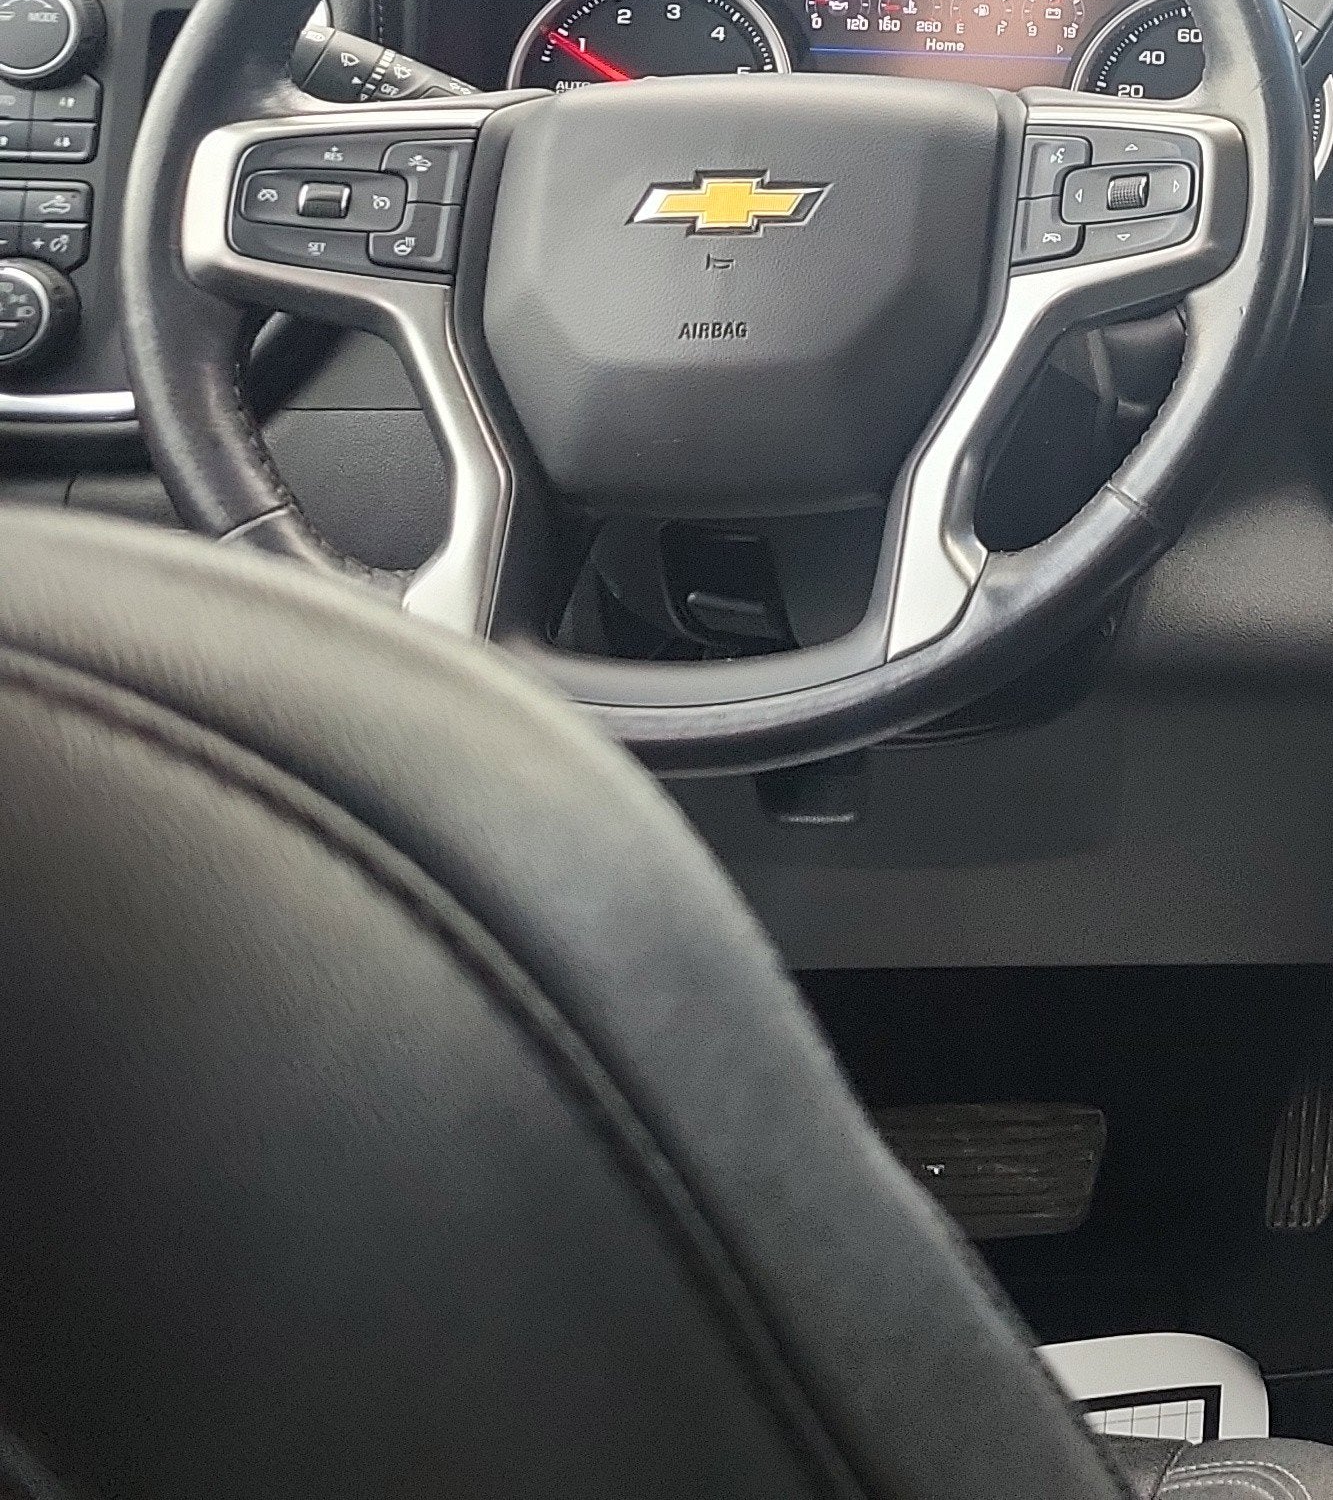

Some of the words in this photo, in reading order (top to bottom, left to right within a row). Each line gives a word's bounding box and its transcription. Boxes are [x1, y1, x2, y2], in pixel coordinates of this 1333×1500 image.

[28, 11, 60, 23] MODE
[616, 8, 633, 25] 2
[666, 4, 682, 20] 3
[811, 17, 822, 30] 0
[846, 18, 869, 31] 120
[878, 18, 900, 31] 160
[916, 20, 942, 33] 260
[956, 23, 966, 34] E
[996, 23, 1006, 36] F
[710, 25, 727, 42] 4
[1028, 25, 1038, 37] 9
[1063, 26, 1077, 39] 19
[1177, 28, 1203, 43] 60
[577, 37, 587, 52] 1
[925, 38, 965, 52] Home
[1138, 50, 1165, 65] 40
[380, 83, 399, 96] OFF
[1118, 84, 1144, 98] 20
[323, 151, 343, 162] RES
[307, 241, 327, 253] SET
[678, 322, 748, 340] AIRBAG
